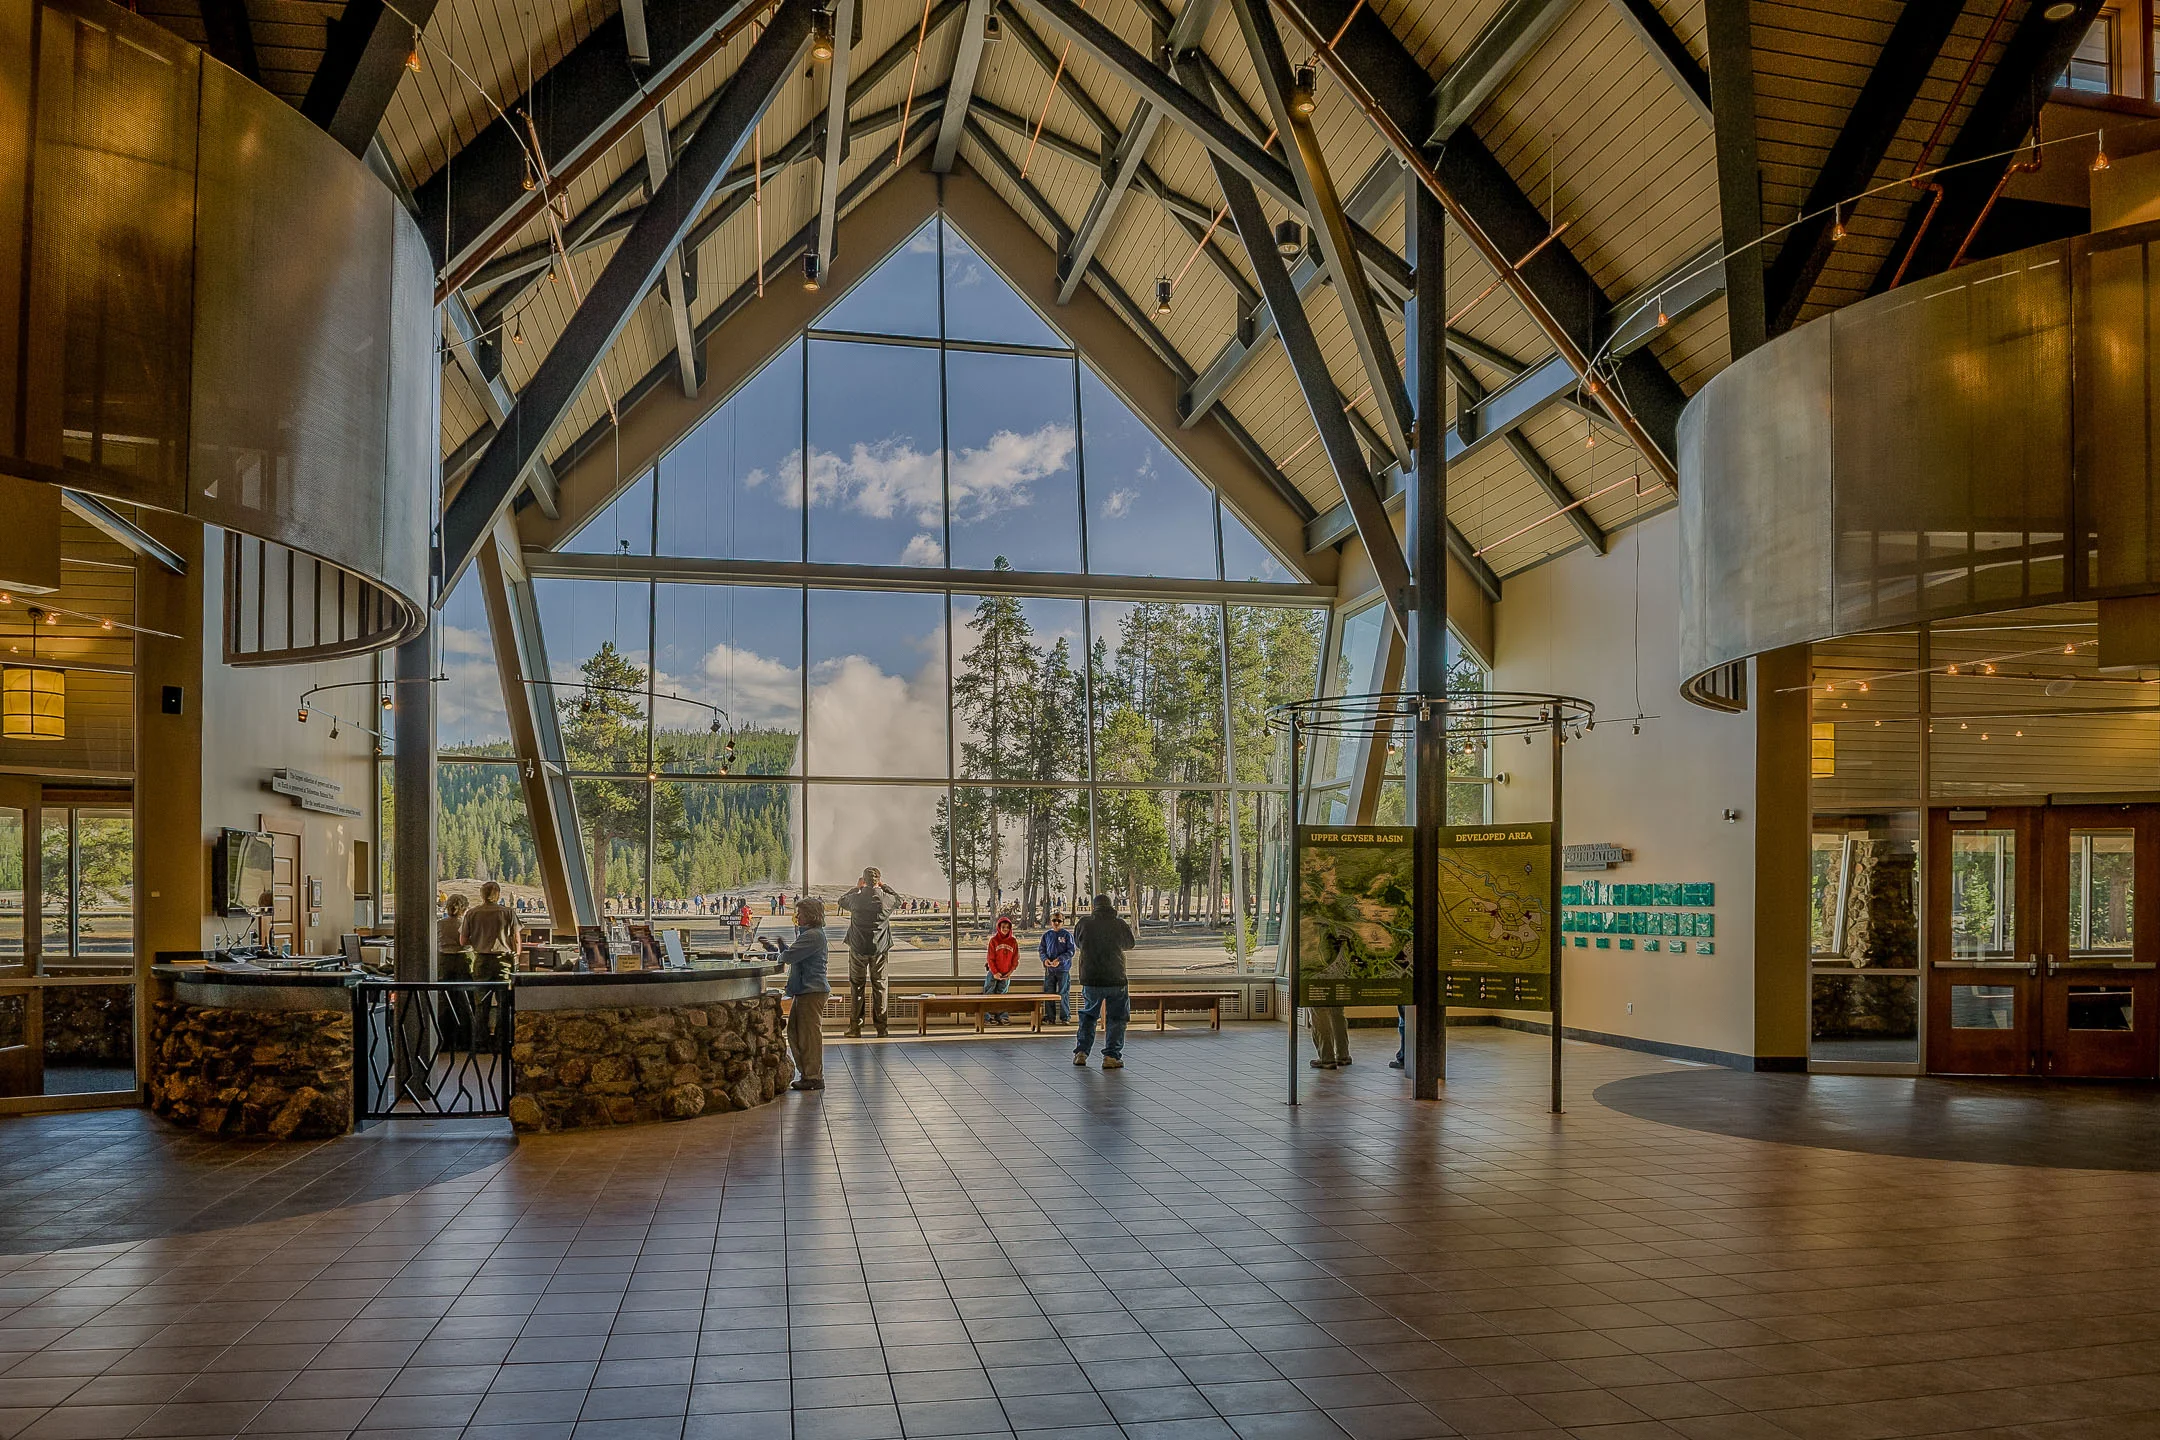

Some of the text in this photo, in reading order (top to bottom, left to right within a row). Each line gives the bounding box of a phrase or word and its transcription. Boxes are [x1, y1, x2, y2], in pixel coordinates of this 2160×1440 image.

[1311, 834, 1404, 843] UPPER GEYSER BASIN
[1455, 831, 1533, 842] DEVELOPED AREA
